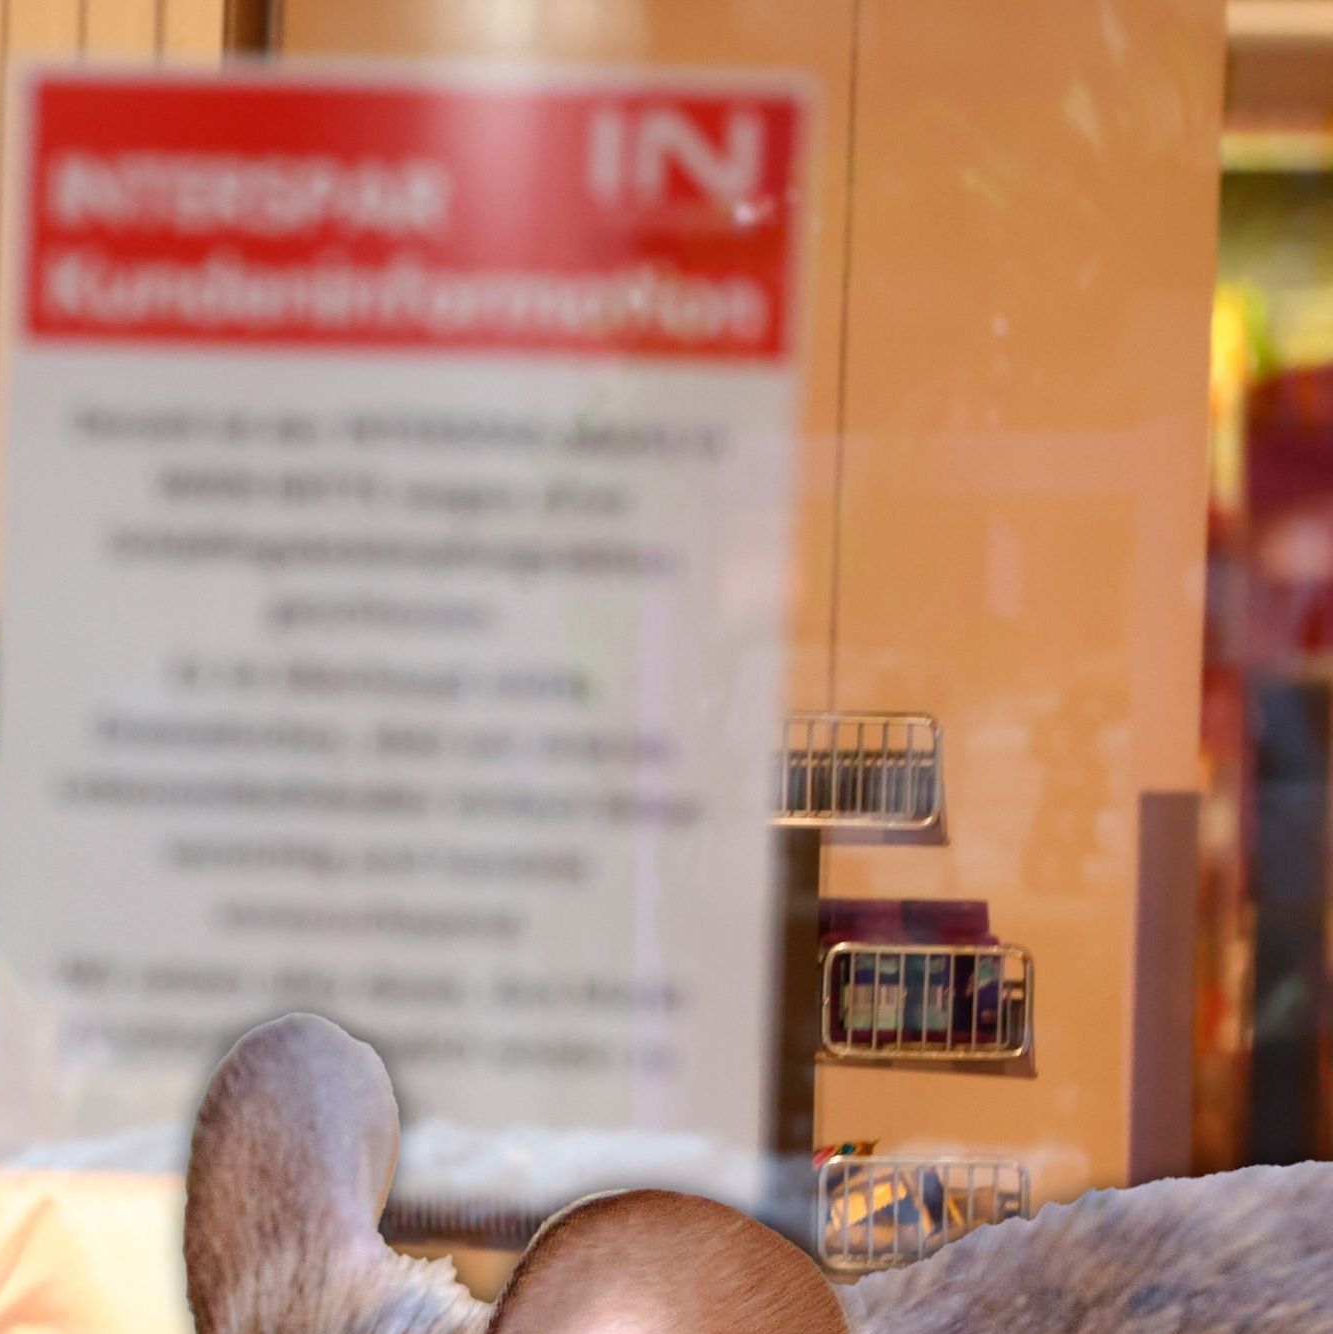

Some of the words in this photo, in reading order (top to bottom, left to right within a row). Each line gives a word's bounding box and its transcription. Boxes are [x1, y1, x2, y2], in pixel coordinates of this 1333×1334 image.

[49, 152, 451, 233] INTERSPAR
[589, 108, 761, 202] IN
[47, 250, 767, 340] Kundeninformation
